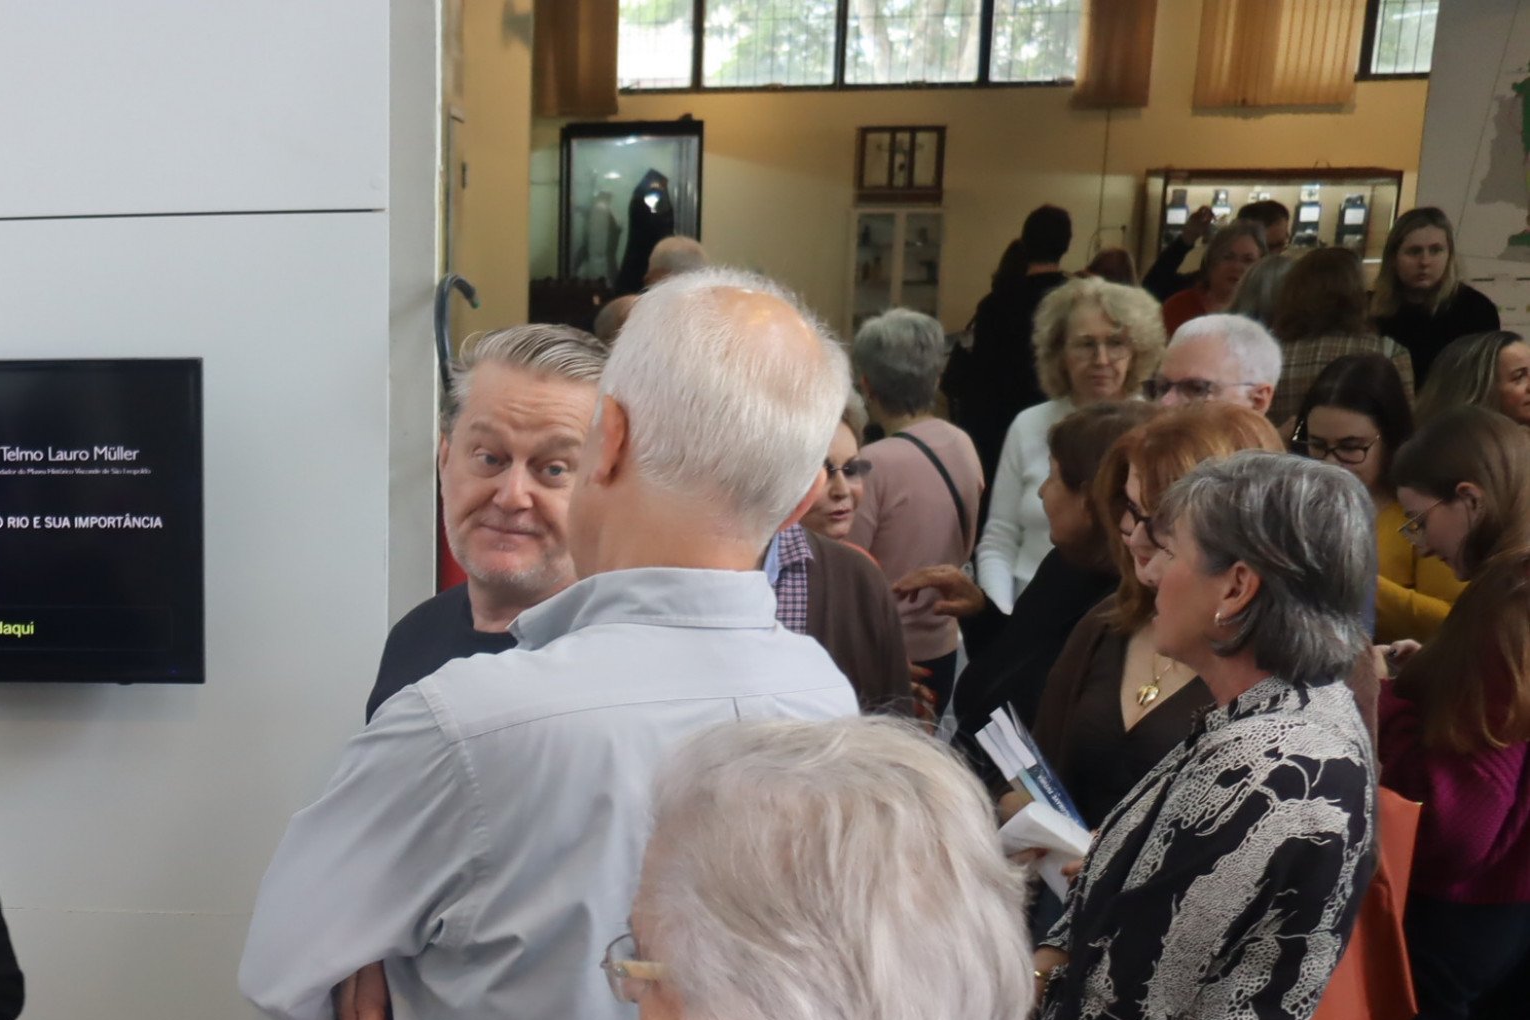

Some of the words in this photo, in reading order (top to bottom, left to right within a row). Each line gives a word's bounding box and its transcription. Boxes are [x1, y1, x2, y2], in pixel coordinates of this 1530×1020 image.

[0, 446, 44, 462] Telmo
[48, 447, 90, 462] Lauro
[93, 445, 140, 461] Müller
[7, 516, 30, 529] RIO
[32, 516, 41, 529] E
[44, 516, 71, 529] SUA
[74, 513, 163, 529] IMPORTÂNCIA
